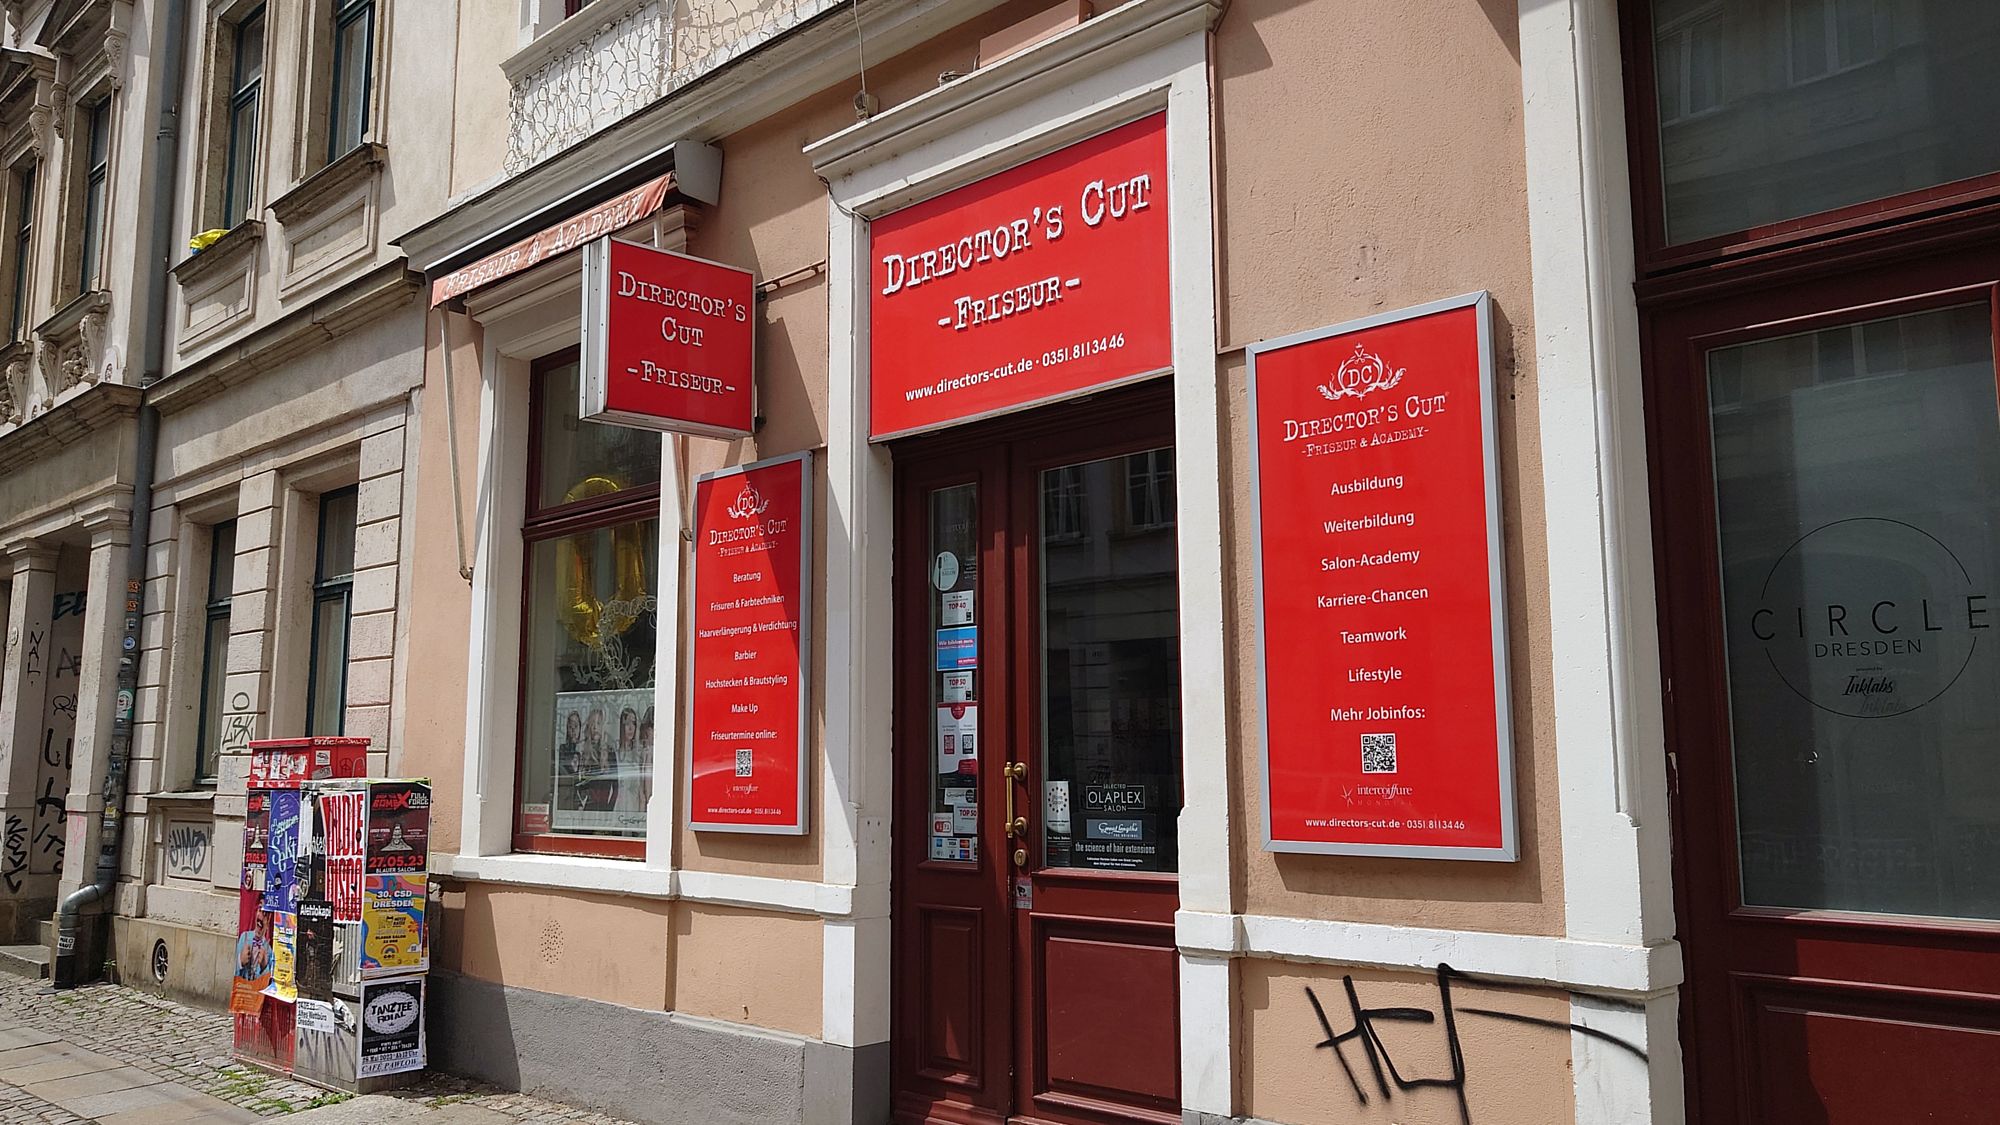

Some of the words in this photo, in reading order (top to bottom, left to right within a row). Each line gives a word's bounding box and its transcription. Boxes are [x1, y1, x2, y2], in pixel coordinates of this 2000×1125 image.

[882, 205, 1063, 296] DIRECTOR'S
[1081, 174, 1151, 227] CUT
[446, 250, 520, 299] FRISEUR
[528, 239, 541, 264] &
[549, 193, 643, 256] ACADEMY
[617, 271, 747, 323] DIRECTOR'S
[661, 316, 704, 347] CUT
[905, 357, 1033, 402] www.directors-cut.de
[1348, 365, 1373, 387] DC
[1283, 404, 1398, 442] DIRECTOR'S
[1405, 395, 1446, 418] CUT
[1359, 437, 1367, 448] &
[1331, 475, 1404, 496] Ausbildung
[741, 496, 754, 510] DC
[1324, 511, 1415, 534] Weiterbildung
[709, 525, 765, 545] DIRECTOR'S
[767, 519, 787, 534] CUT
[1321, 549, 1420, 571] Salon-Academy
[733, 571, 761, 583] Beratung
[710, 600, 734, 611] Frisuren
[735, 599, 740, 608] &
[741, 595, 785, 608] Farbtechniken
[1317, 587, 1429, 608] Karriere-Chancen
[1751, 595, 1990, 641] CIRCLE
[699, 624, 751, 638] Haarverlängerung
[753, 623, 758, 633] &
[758, 620, 797, 632] Verdichtung
[1340, 626, 1407, 644] Teamwork
[734, 650, 757, 660] Barbier
[1814, 639, 1922, 658] DRESDEN
[705, 678, 743, 688] Hochstecken
[744, 677, 749, 686] &
[749, 675, 788, 687] Brautstyling
[1348, 667, 1403, 683] Lifestyle
[1842, 675, 1894, 697] Inklabs
[732, 704, 748, 713] Make
[749, 704, 758, 714] Up
[1331, 708, 1363, 721] Mehr
[1366, 705, 1426, 720] Jobinfos:
[711, 731, 754, 740] Friseurtermine
[755, 730, 778, 739] online:
[1088, 791, 1141, 804] OLAPLEX
[1357, 783, 1413, 799] intercoiffure
[1305, 818, 1400, 829] www.directors-cut.de
[1075, 843, 1084, 852] the
[1085, 843, 1105, 852] science
[1106, 843, 1112, 852] of
[1113, 843, 1124, 853] hair
[1125, 844, 1155, 854] extensions
[368, 856, 424, 868] 27.05.23
[394, 890, 412, 898] CSD
[373, 900, 415, 909] DRESDEN
[371, 1002, 413, 1015] TANZTEE
